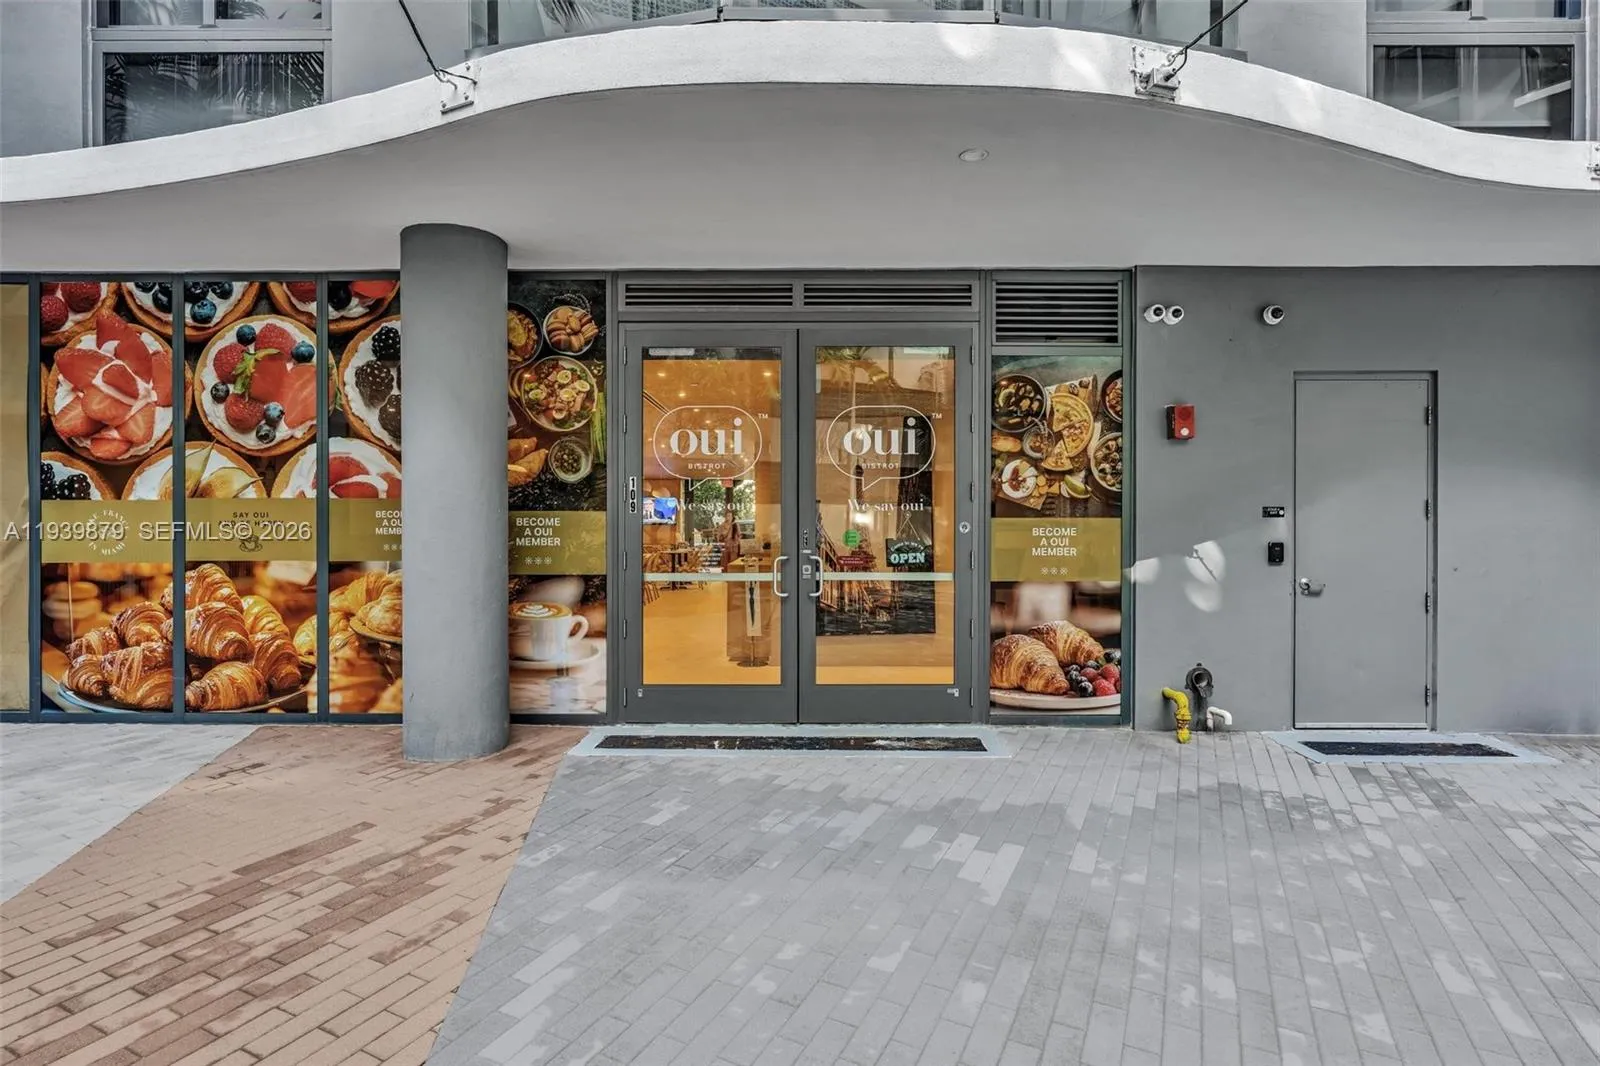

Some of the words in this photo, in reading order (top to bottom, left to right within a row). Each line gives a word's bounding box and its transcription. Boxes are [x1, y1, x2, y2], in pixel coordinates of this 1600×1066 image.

[670, 417, 745, 456] oui
[843, 417, 919, 456] oui
[629, 477, 637, 513] 109
[848, 499, 870, 511] We
[901, 499, 924, 511] oui
[375, 510, 402, 518] BECO
[382, 518, 389, 526] A
[390, 518, 403, 526] OU
[515, 517, 561, 527] BECOME
[375, 527, 402, 535] MEMB
[523, 527, 532, 536] A
[534, 527, 553, 536] OUI
[1032, 527, 1077, 536] BECOME
[515, 537, 561, 547] MEMBER
[1040, 537, 1048, 546] A
[1050, 537, 1069, 546] OUI
[1031, 547, 1077, 556] MEMBER
[890, 552, 925, 564] OPEN
